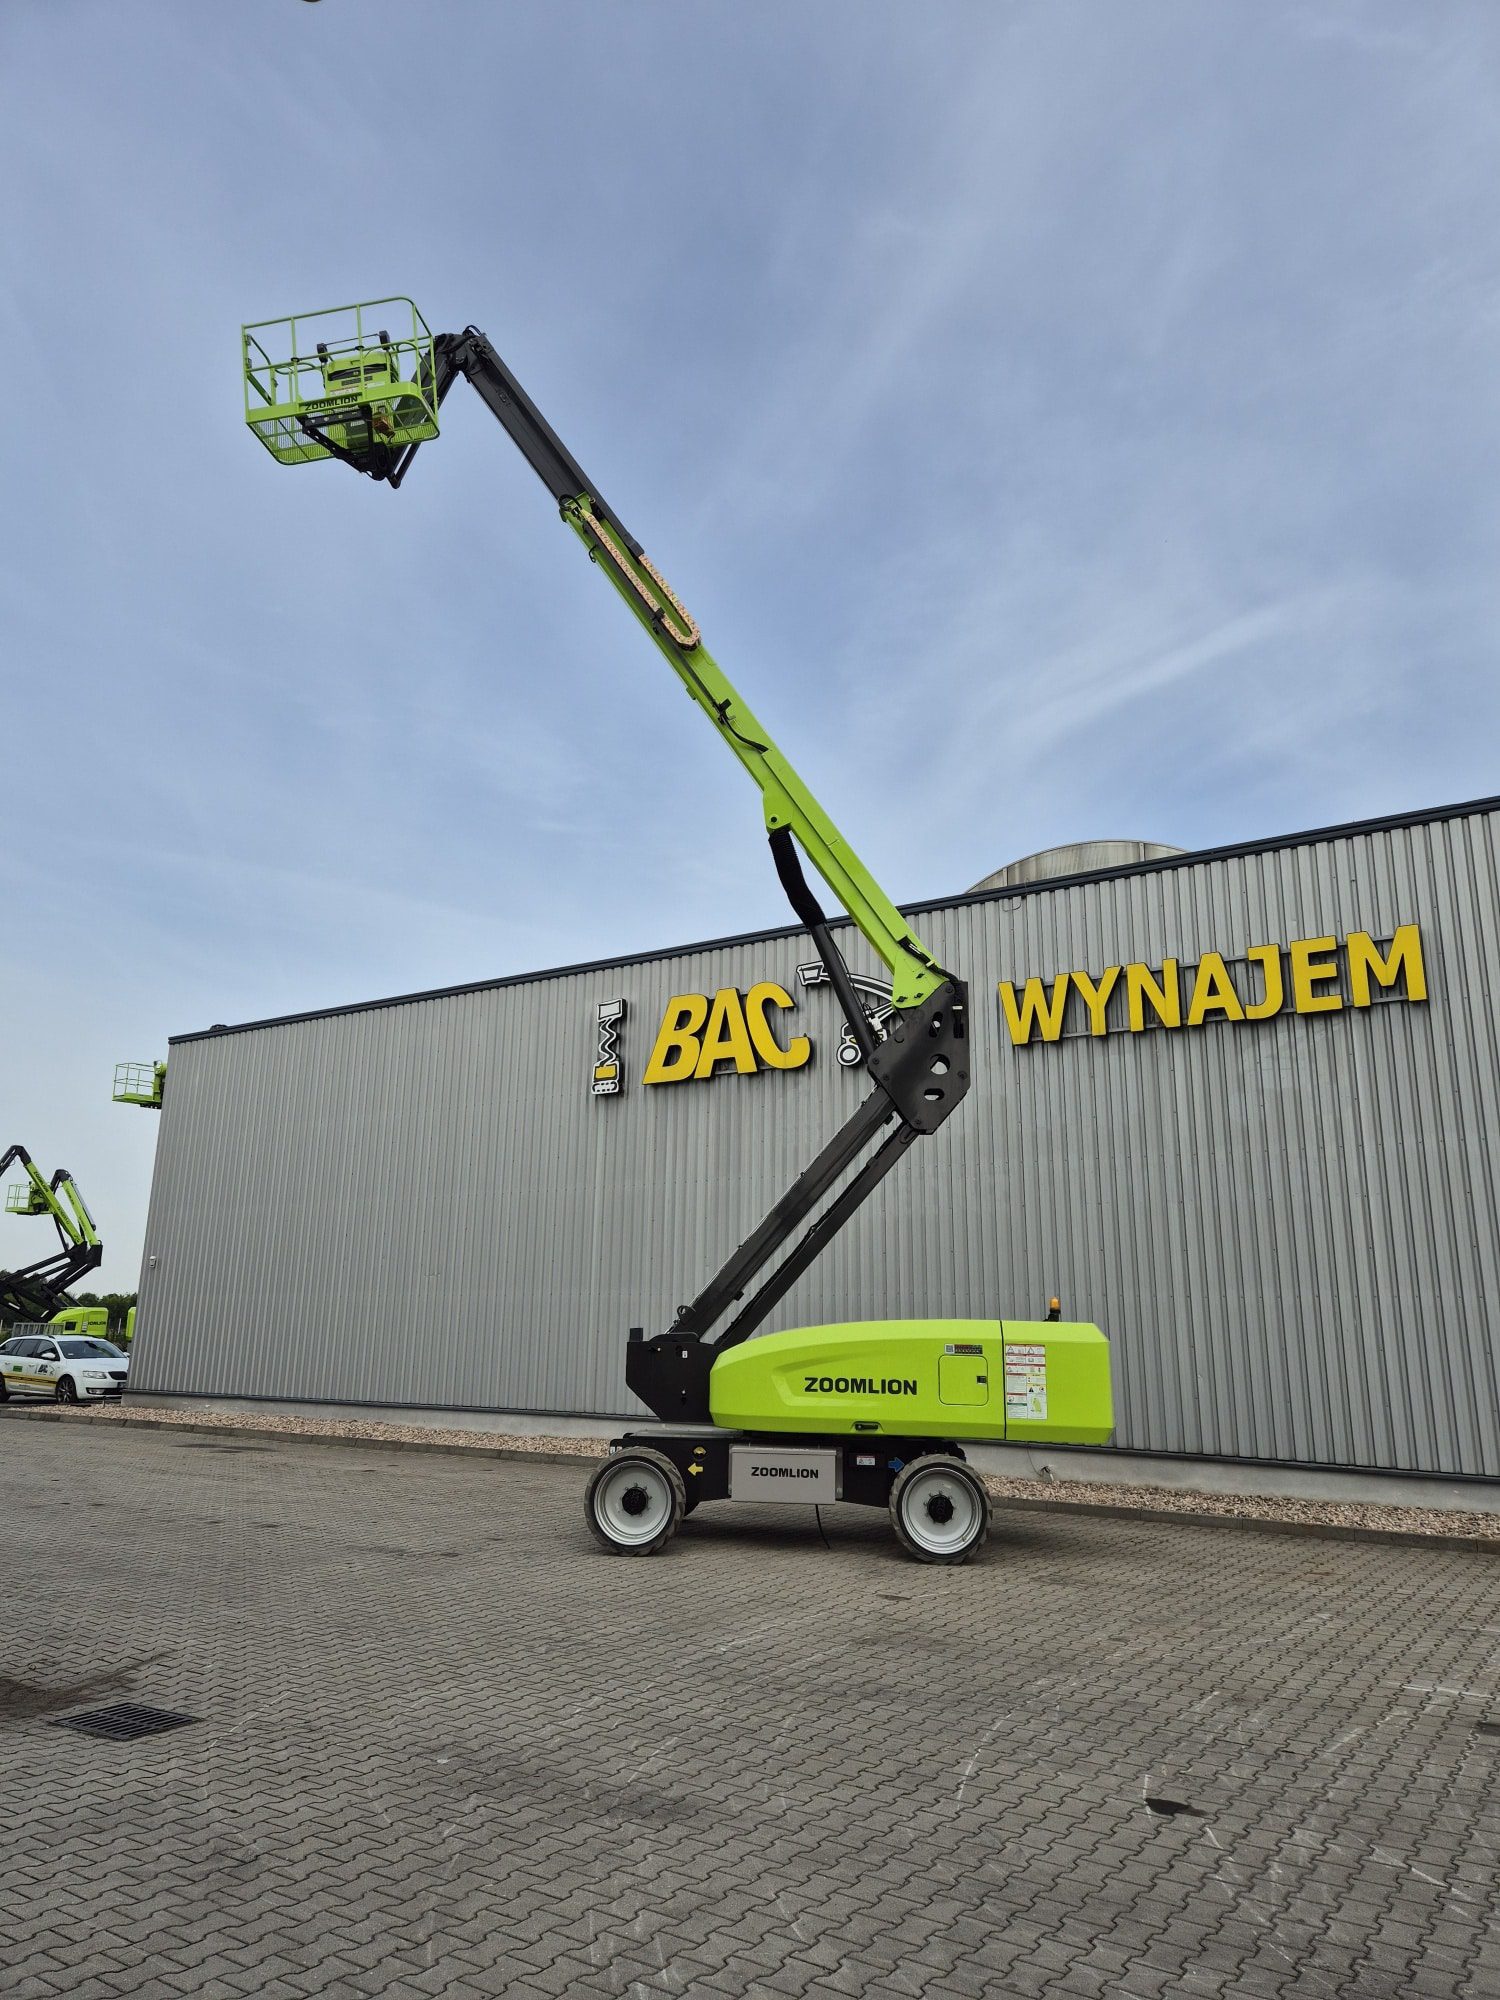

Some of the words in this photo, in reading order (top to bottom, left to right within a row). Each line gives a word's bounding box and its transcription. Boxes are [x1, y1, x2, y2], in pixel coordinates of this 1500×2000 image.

[998, 924, 1427, 1045] WYNAJEM
[642, 982, 810, 1085] BAC
[804, 1377, 917, 1395] ZOOMLION
[751, 1467, 819, 1478] ZOOMLION
